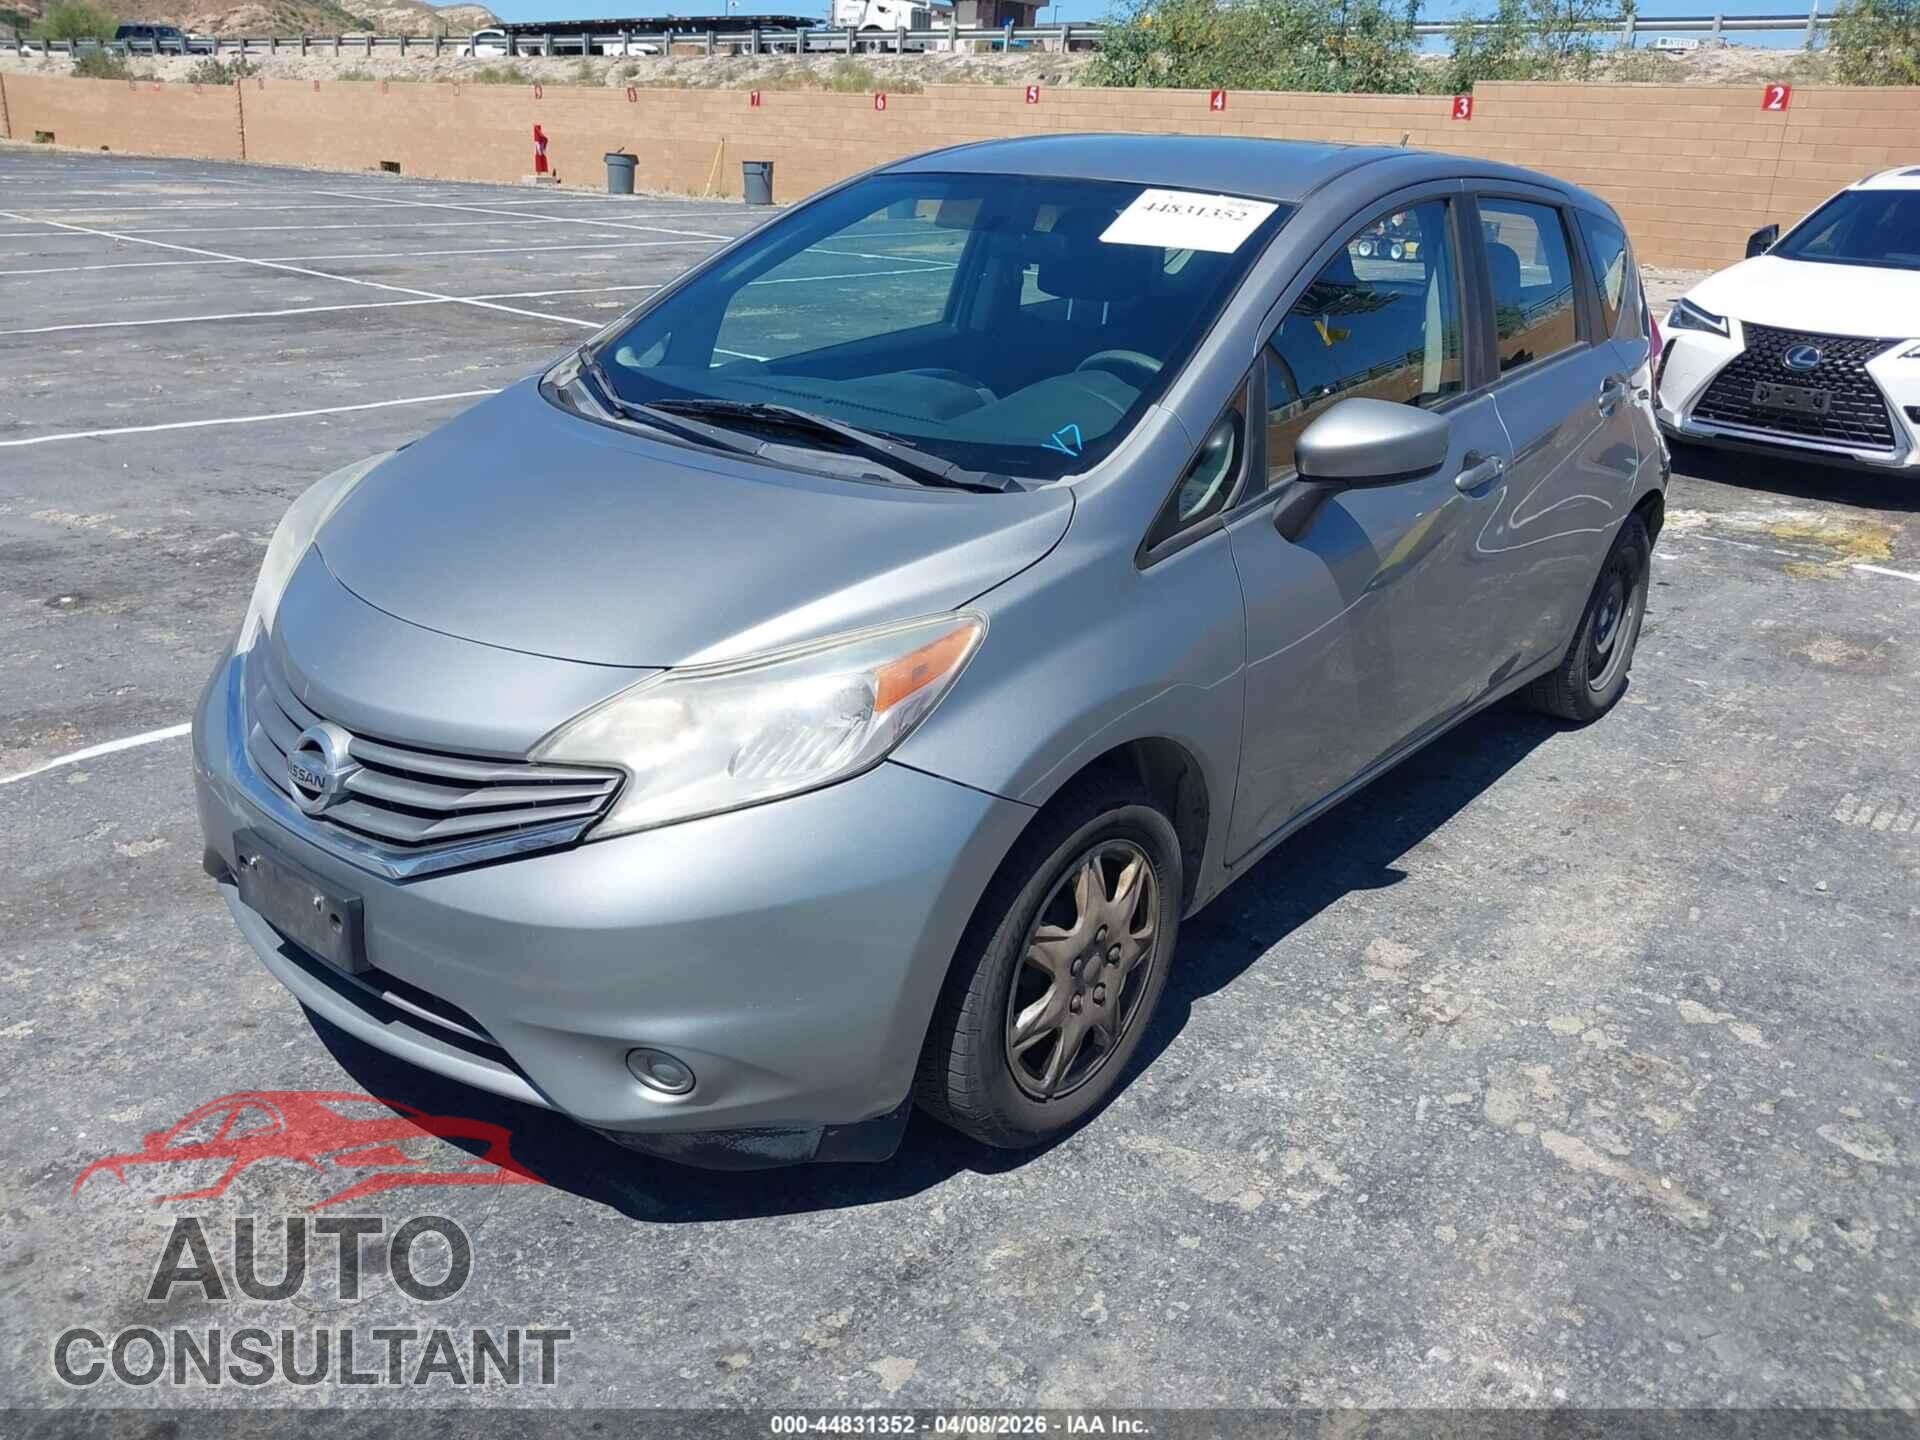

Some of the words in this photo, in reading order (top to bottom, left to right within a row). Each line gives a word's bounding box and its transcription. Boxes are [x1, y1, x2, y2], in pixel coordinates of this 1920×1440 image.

[1027, 86, 1038, 104] 5
[1213, 89, 1224, 111] 4
[1767, 86, 1785, 109] 2
[1455, 97, 1469, 118] 3
[1141, 201, 1249, 222] 44831352
[288, 764, 326, 788] ISSAN
